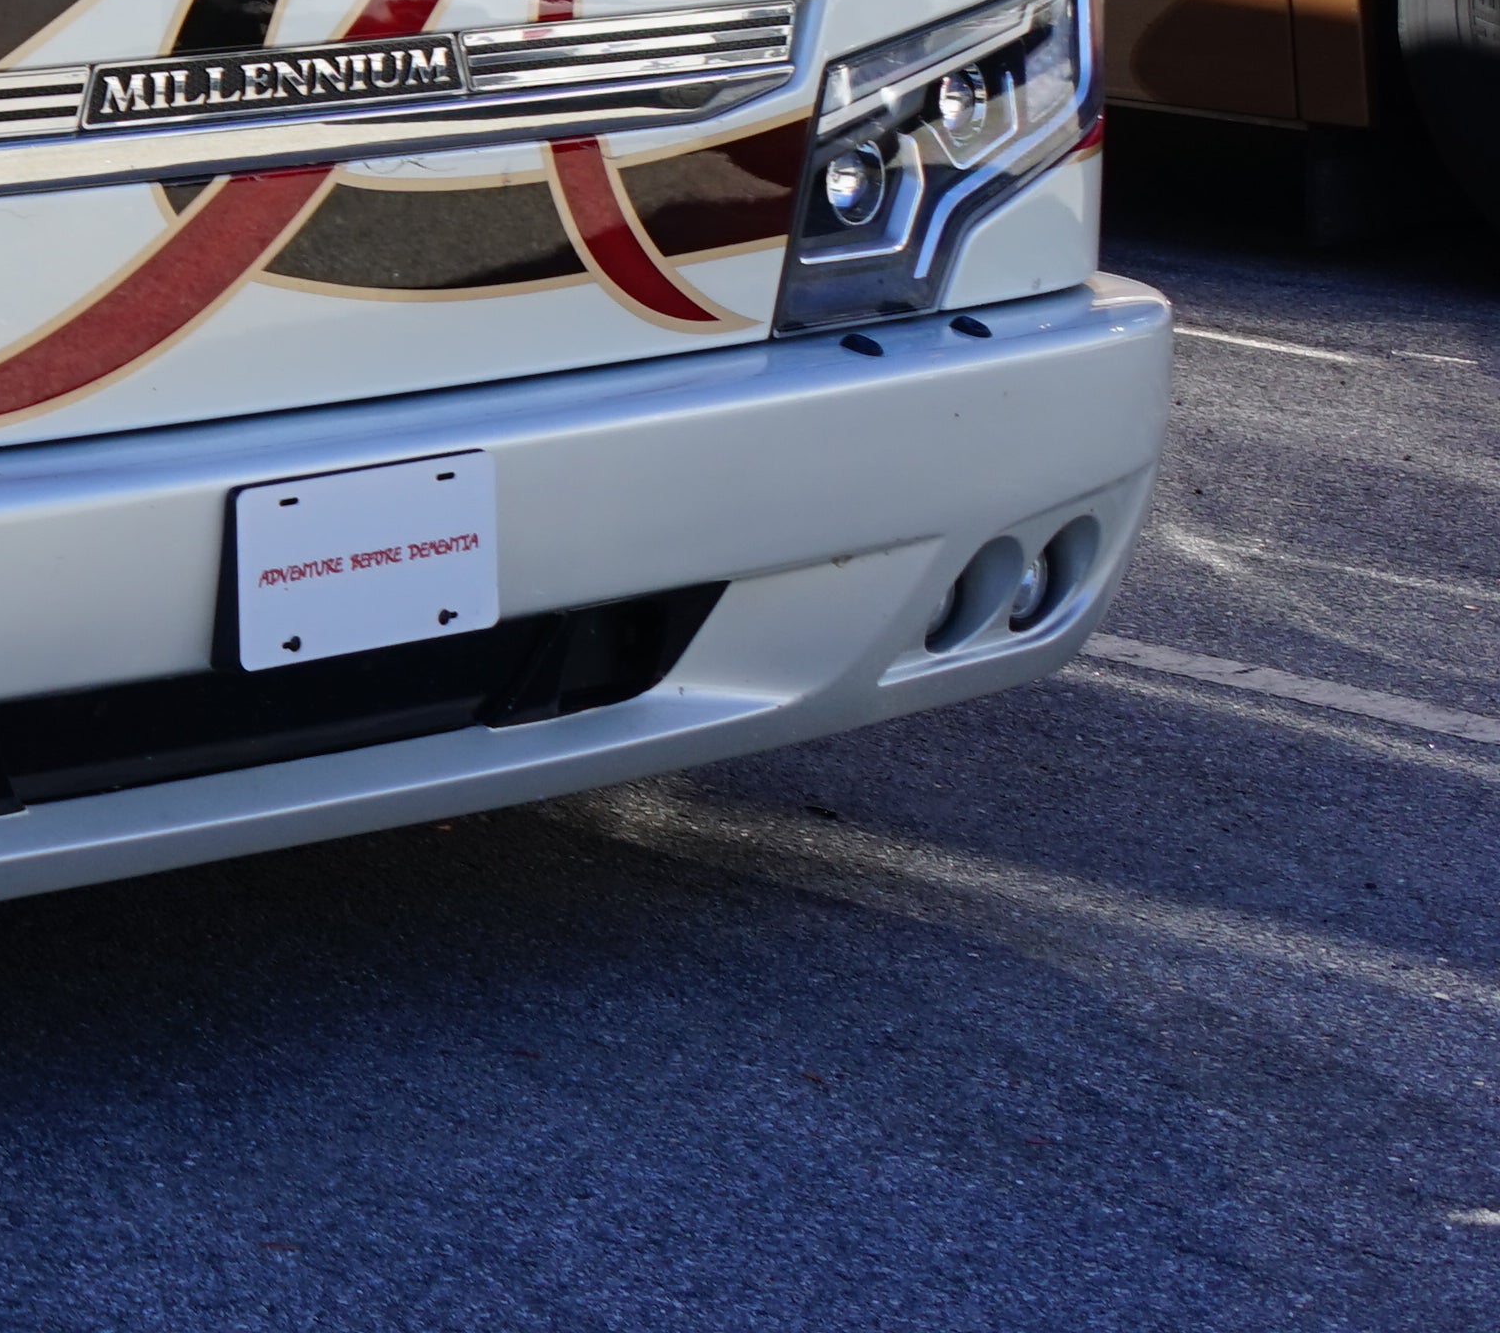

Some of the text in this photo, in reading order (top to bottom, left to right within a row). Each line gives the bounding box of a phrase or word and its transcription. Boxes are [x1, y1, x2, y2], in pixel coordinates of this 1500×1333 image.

[100, 49, 450, 114] MILLENNIUM
[258, 533, 479, 587] ADVENTURE BEFORE DEMENTIA
